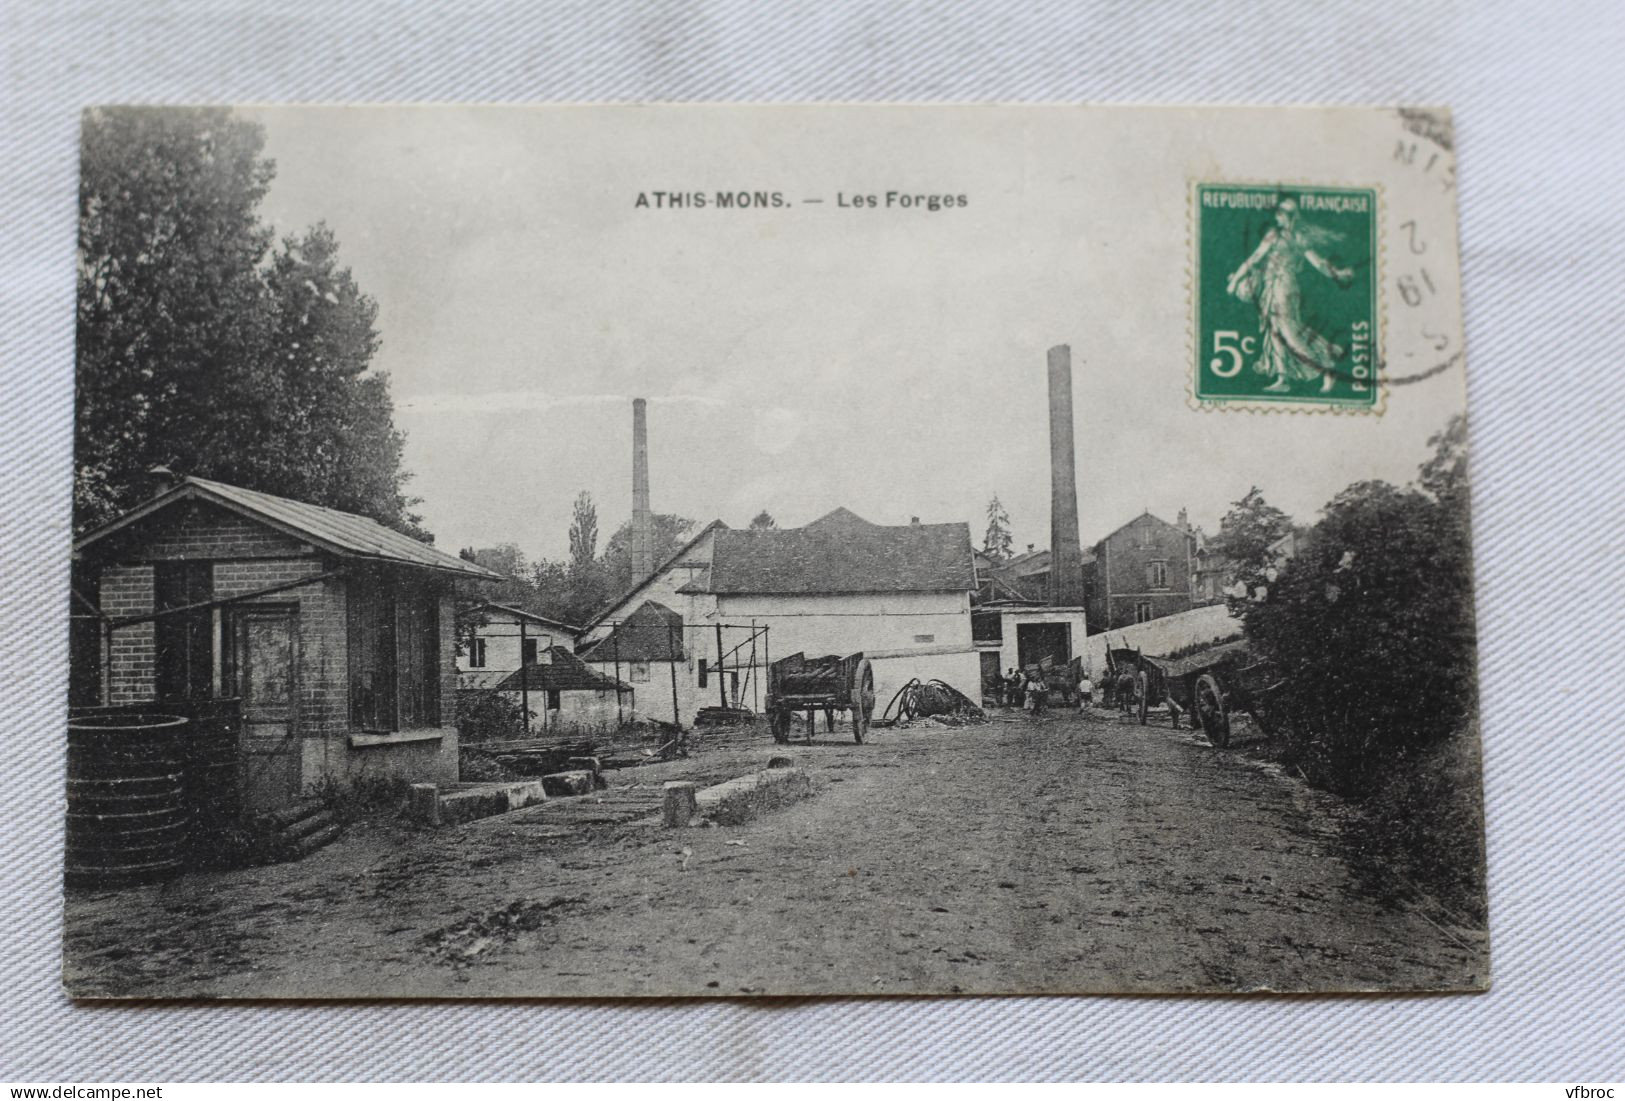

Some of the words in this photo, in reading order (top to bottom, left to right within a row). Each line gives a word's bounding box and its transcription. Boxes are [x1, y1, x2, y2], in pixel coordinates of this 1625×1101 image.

[634, 191, 792, 209] ATHIS-MONS.
[837, 191, 878, 208] Les
[885, 191, 969, 212] Forges
[1351, 320, 1369, 392] POSTES
